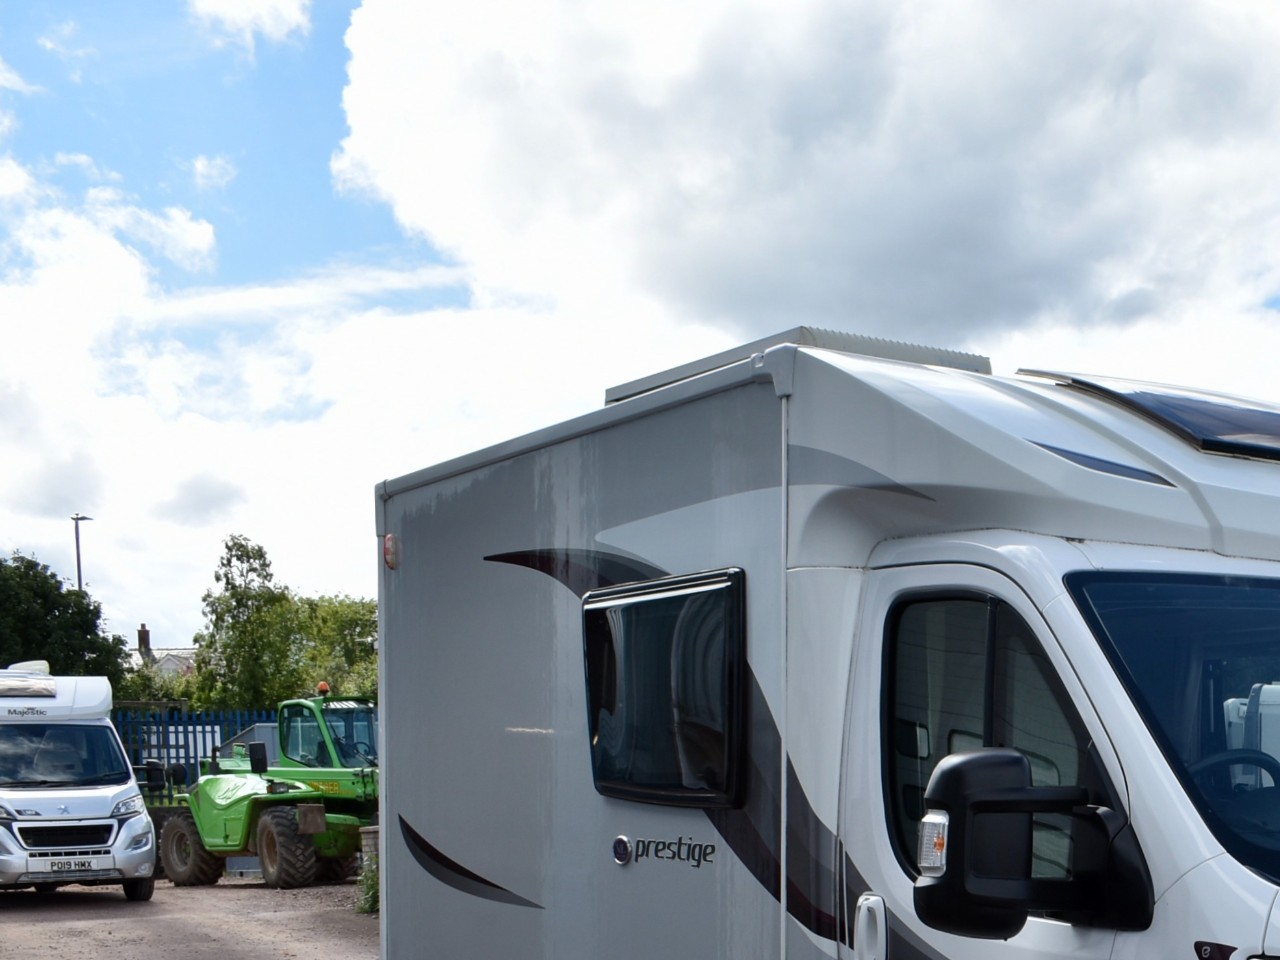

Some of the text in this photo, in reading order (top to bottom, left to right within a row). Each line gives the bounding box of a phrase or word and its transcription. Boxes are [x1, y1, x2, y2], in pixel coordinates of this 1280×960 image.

[7, 709, 47, 717] Majestic
[634, 836, 716, 868] prestige
[50, 860, 93, 871] PO19 HMX
